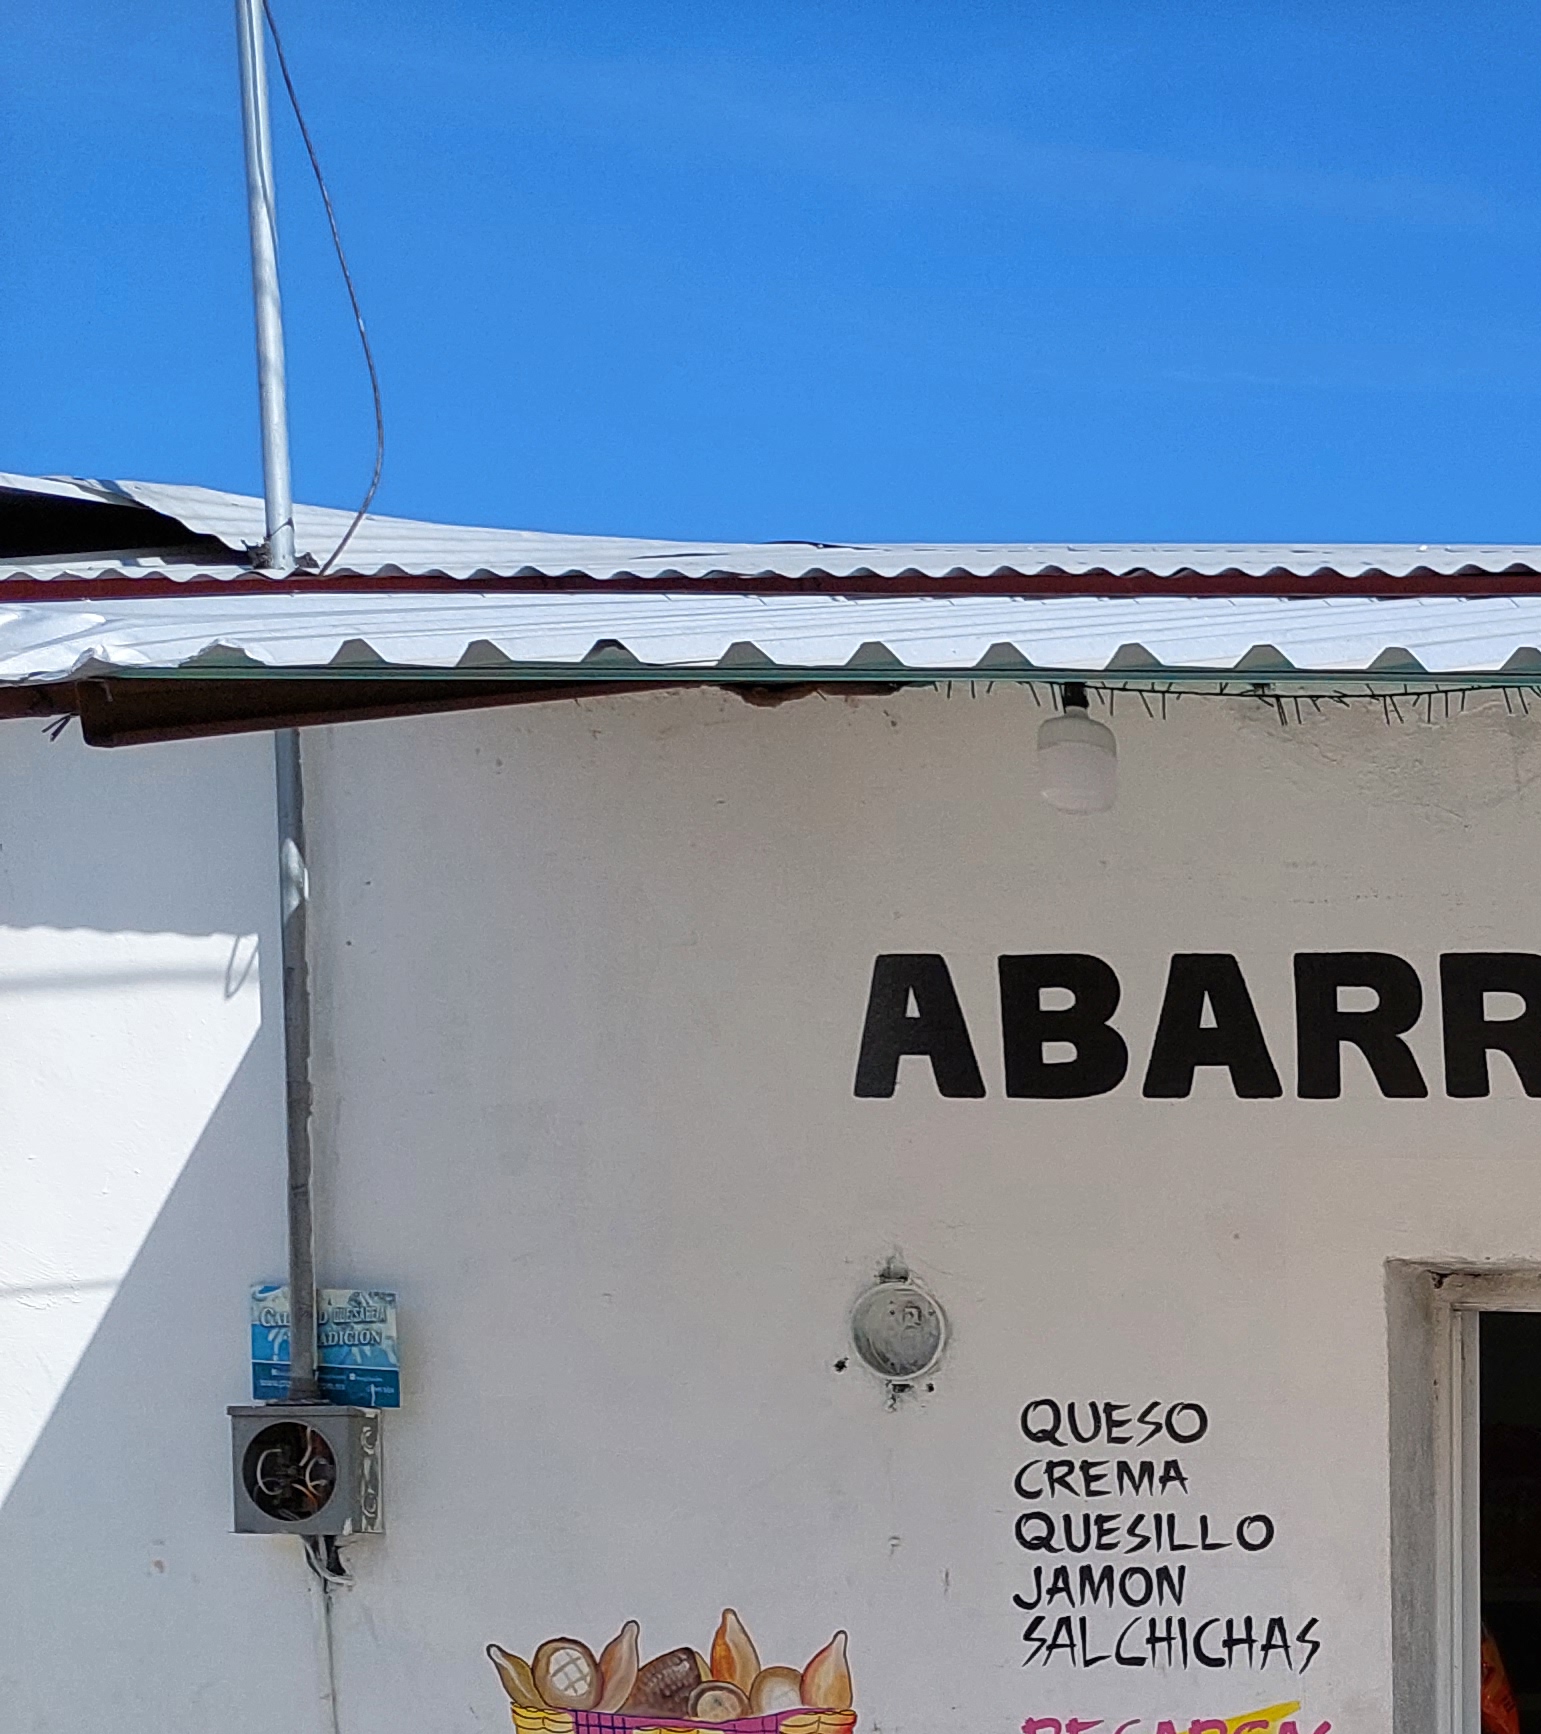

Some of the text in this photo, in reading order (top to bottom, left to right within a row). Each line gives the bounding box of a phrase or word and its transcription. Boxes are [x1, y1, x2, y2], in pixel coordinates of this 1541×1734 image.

[1020, 1399, 1208, 1447] QUESO
[1014, 1459, 1188, 1500] CREMA
[1014, 1511, 1275, 1554] QUESILLO
[1013, 1564, 1187, 1610] JAMON
[1021, 1615, 1321, 1675] SALCHICHAS
